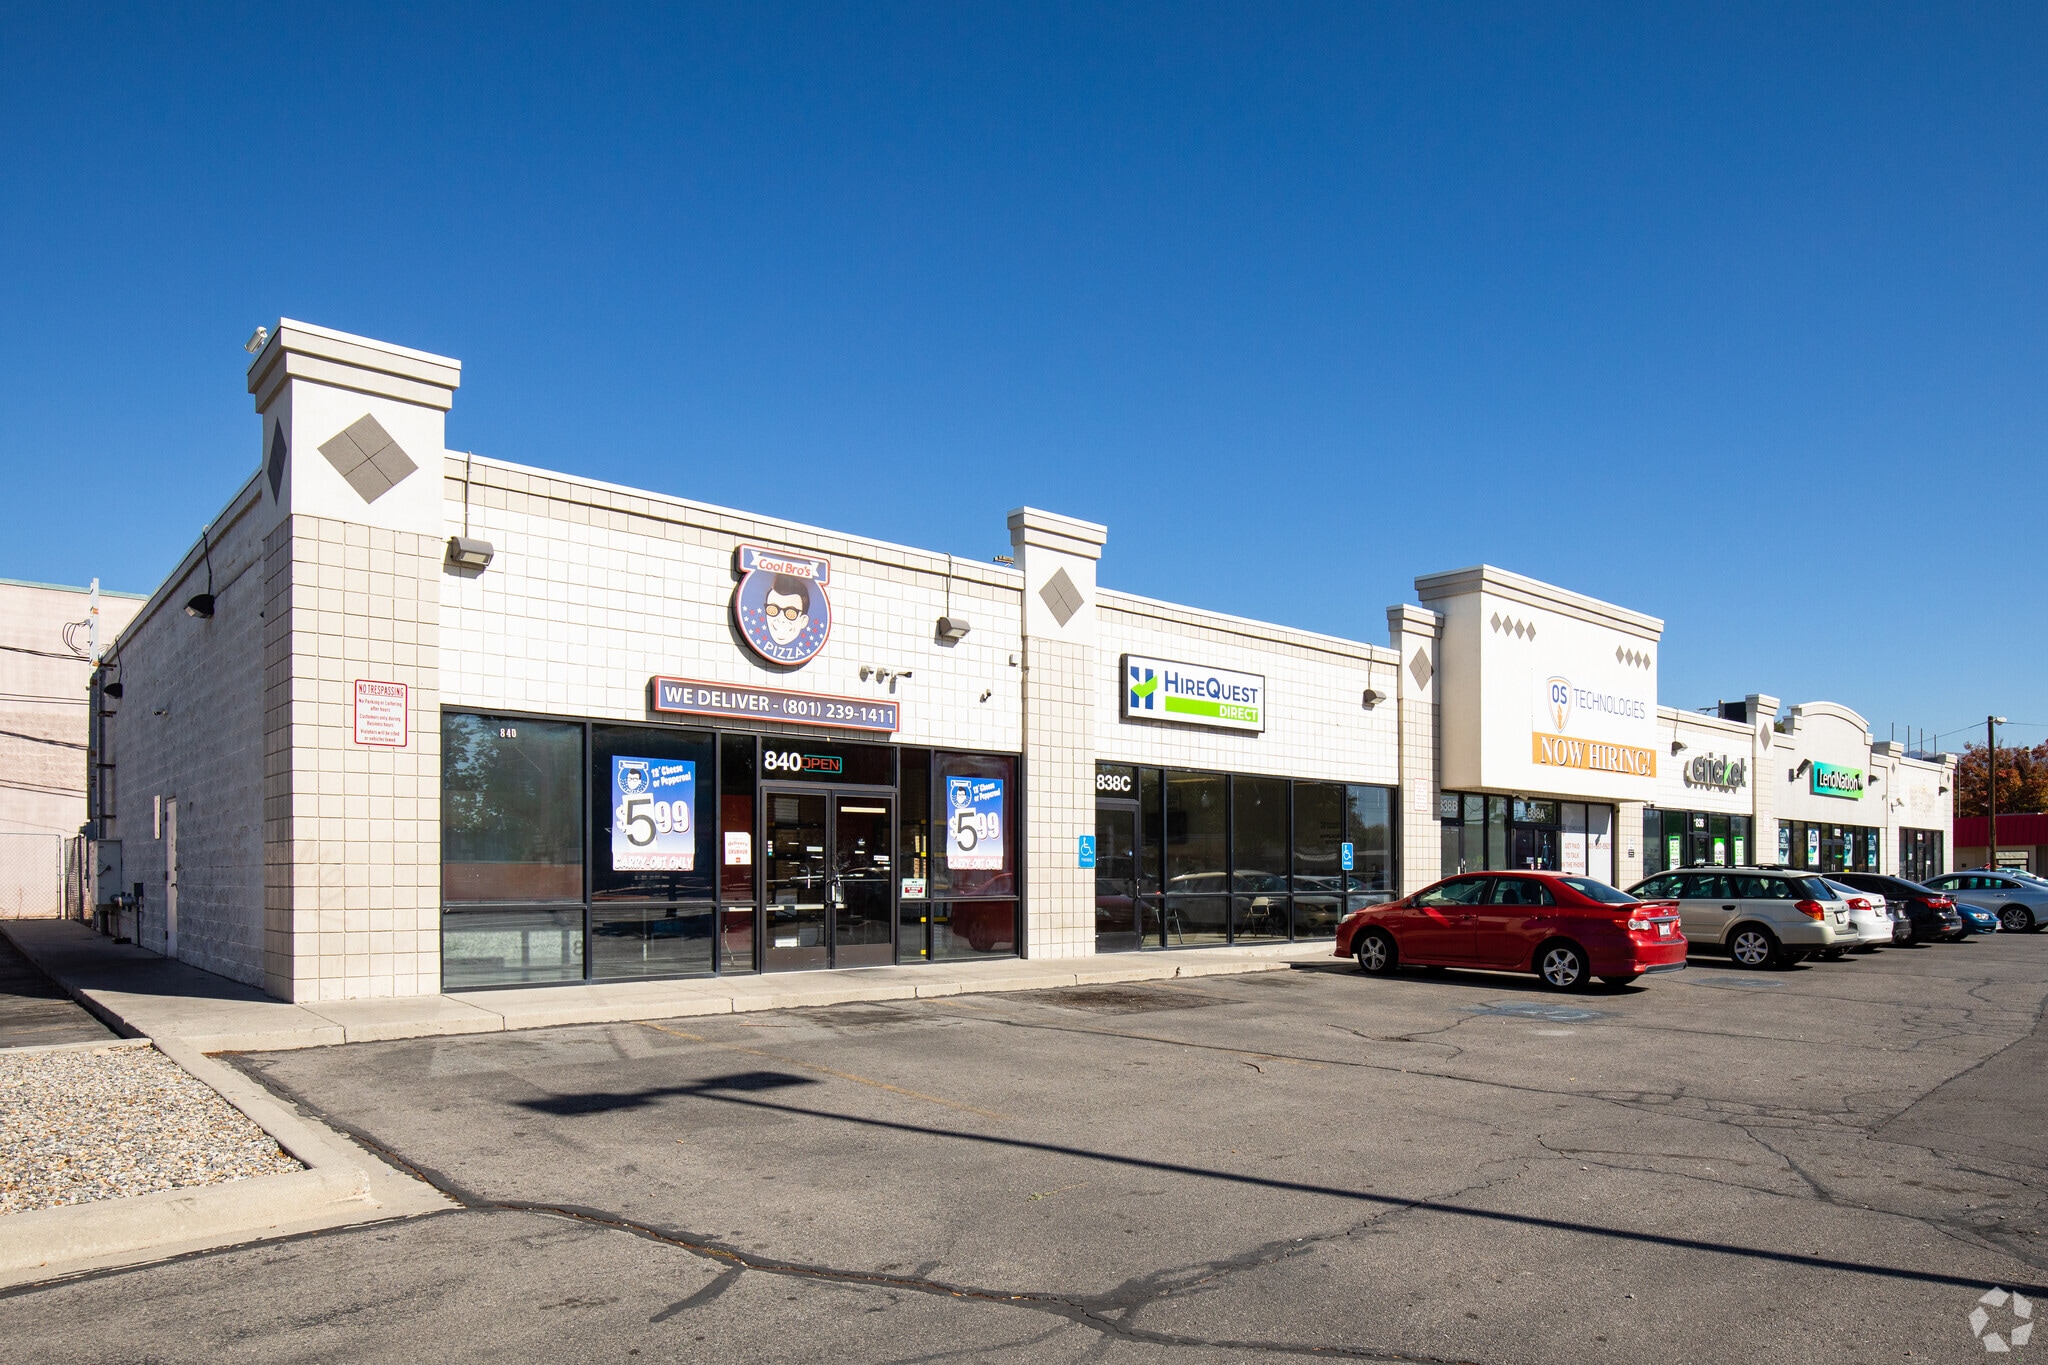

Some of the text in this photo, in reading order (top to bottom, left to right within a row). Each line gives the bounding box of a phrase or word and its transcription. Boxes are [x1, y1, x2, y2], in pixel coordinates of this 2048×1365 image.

[758, 558, 811, 577] Cool Bro's
[763, 641, 805, 660] PIZZA
[358, 684, 404, 696] NO TRESPASSING
[1551, 684, 1568, 705] OS
[664, 685, 693, 705] WE
[697, 689, 769, 712] DELIVER
[782, 698, 821, 717] (801)
[826, 703, 894, 725] 239-1411
[1219, 705, 1258, 721] DIRECT
[1573, 687, 1645, 720] TECHNOLOGIES
[764, 750, 801, 772] 840
[800, 757, 839, 771] OPEN
[1540, 736, 1651, 777] NOW HIRING!
[652, 771, 692, 788] or Pepperoni
[661, 765, 684, 776] Cheese
[1692, 752, 1747, 788] cricket
[1819, 768, 1859, 791] LendNation
[1096, 774, 1132, 792] 838C
[1527, 807, 1546, 819] 838A
[614, 855, 693, 870] CARRY-OUT ONLY
